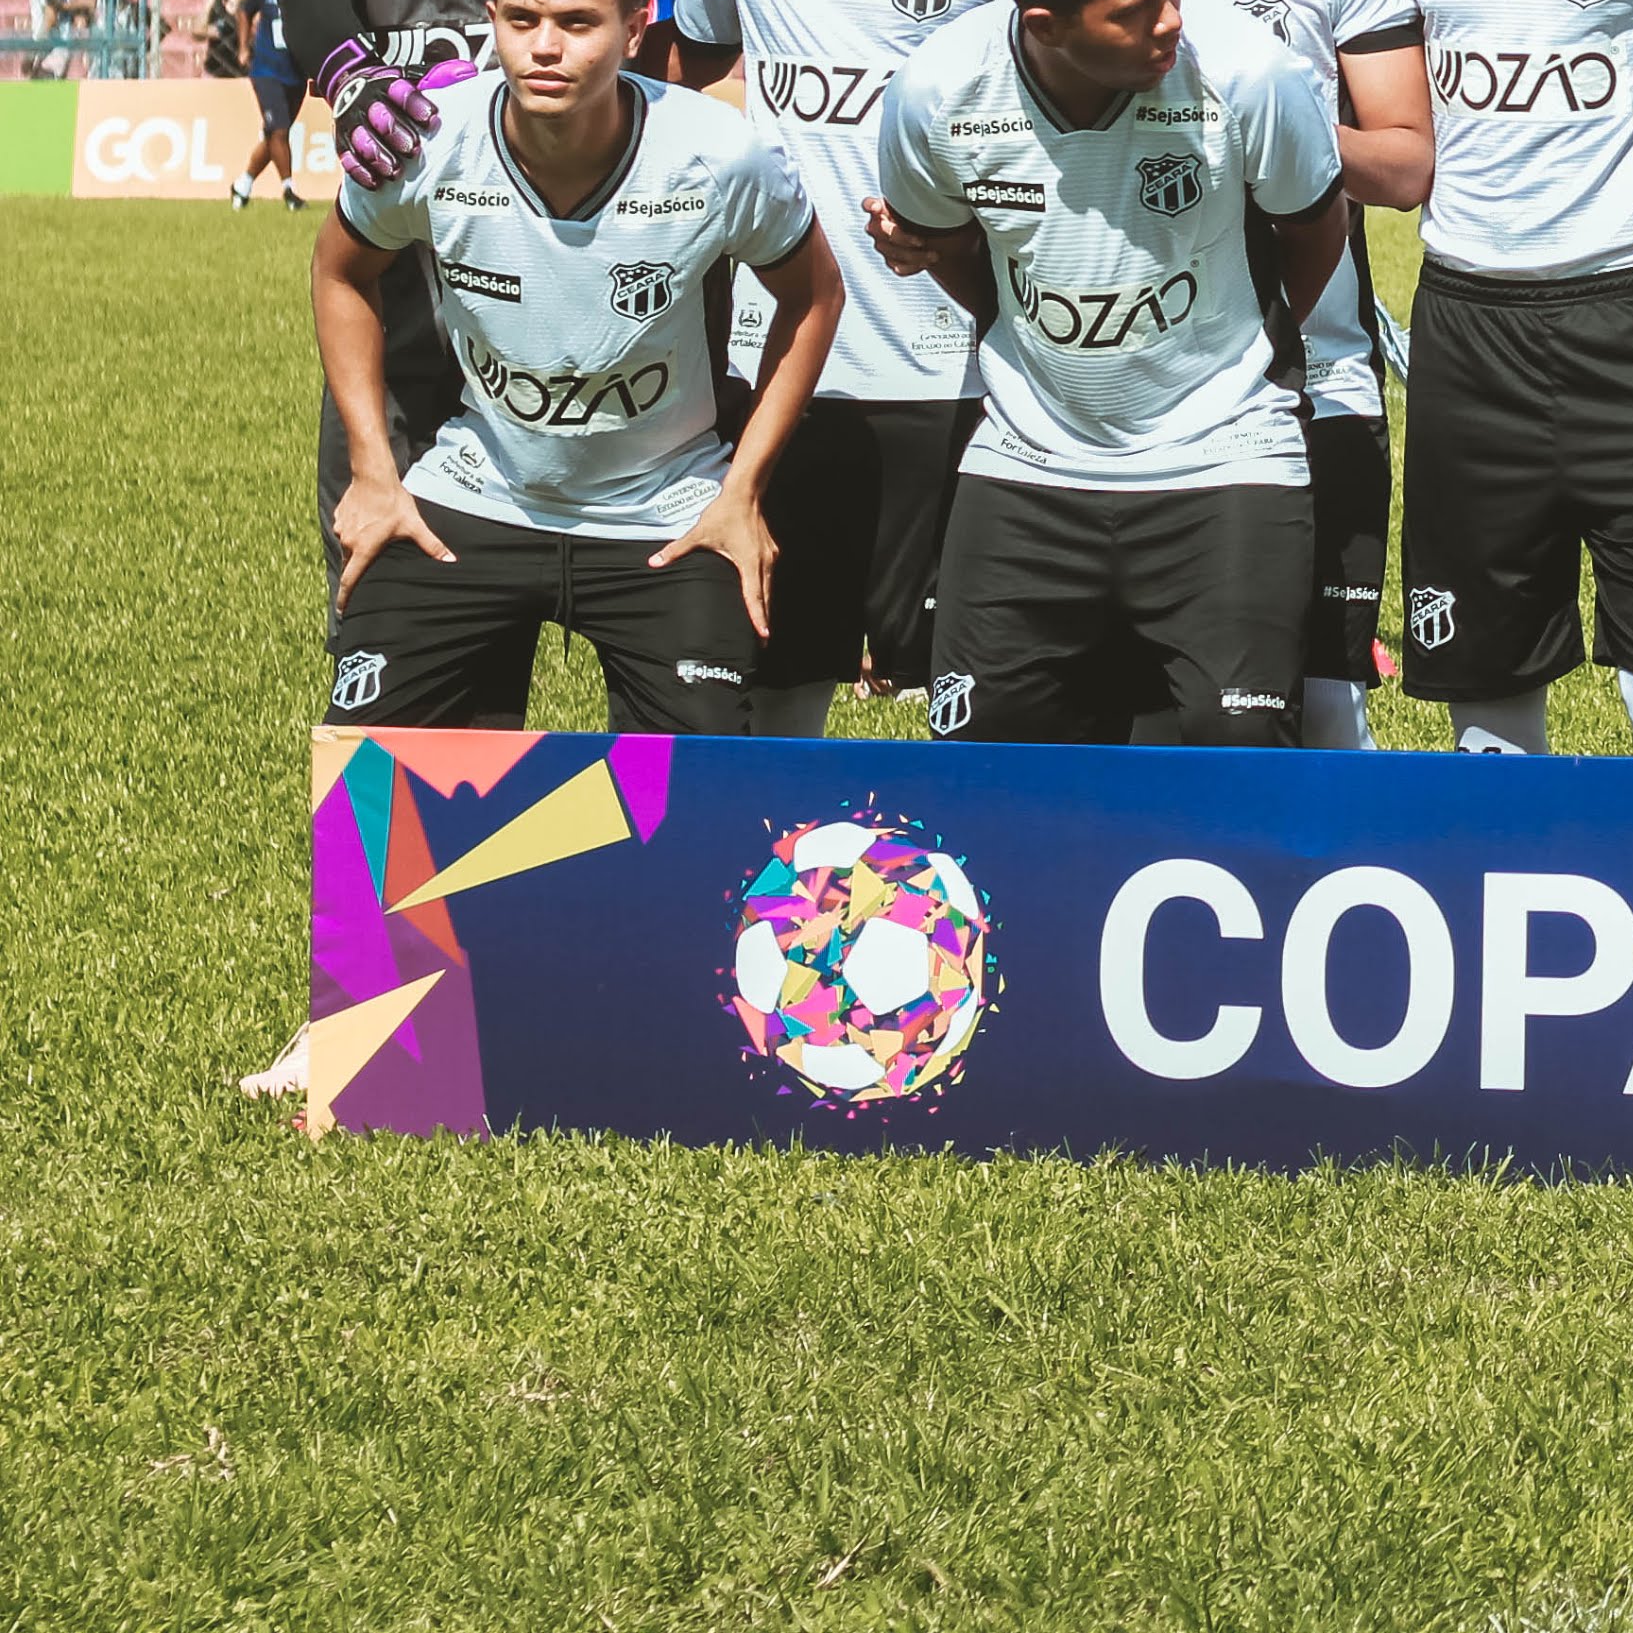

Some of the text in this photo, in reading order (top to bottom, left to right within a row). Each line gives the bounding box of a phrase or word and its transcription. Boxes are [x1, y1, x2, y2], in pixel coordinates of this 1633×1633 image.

[951, 114, 1034, 137] #SejaSócio
[1136, 105, 1219, 126] #SejaSócio
[84, 117, 223, 183] GOL
[616, 197, 705, 217] #SejaSócio
